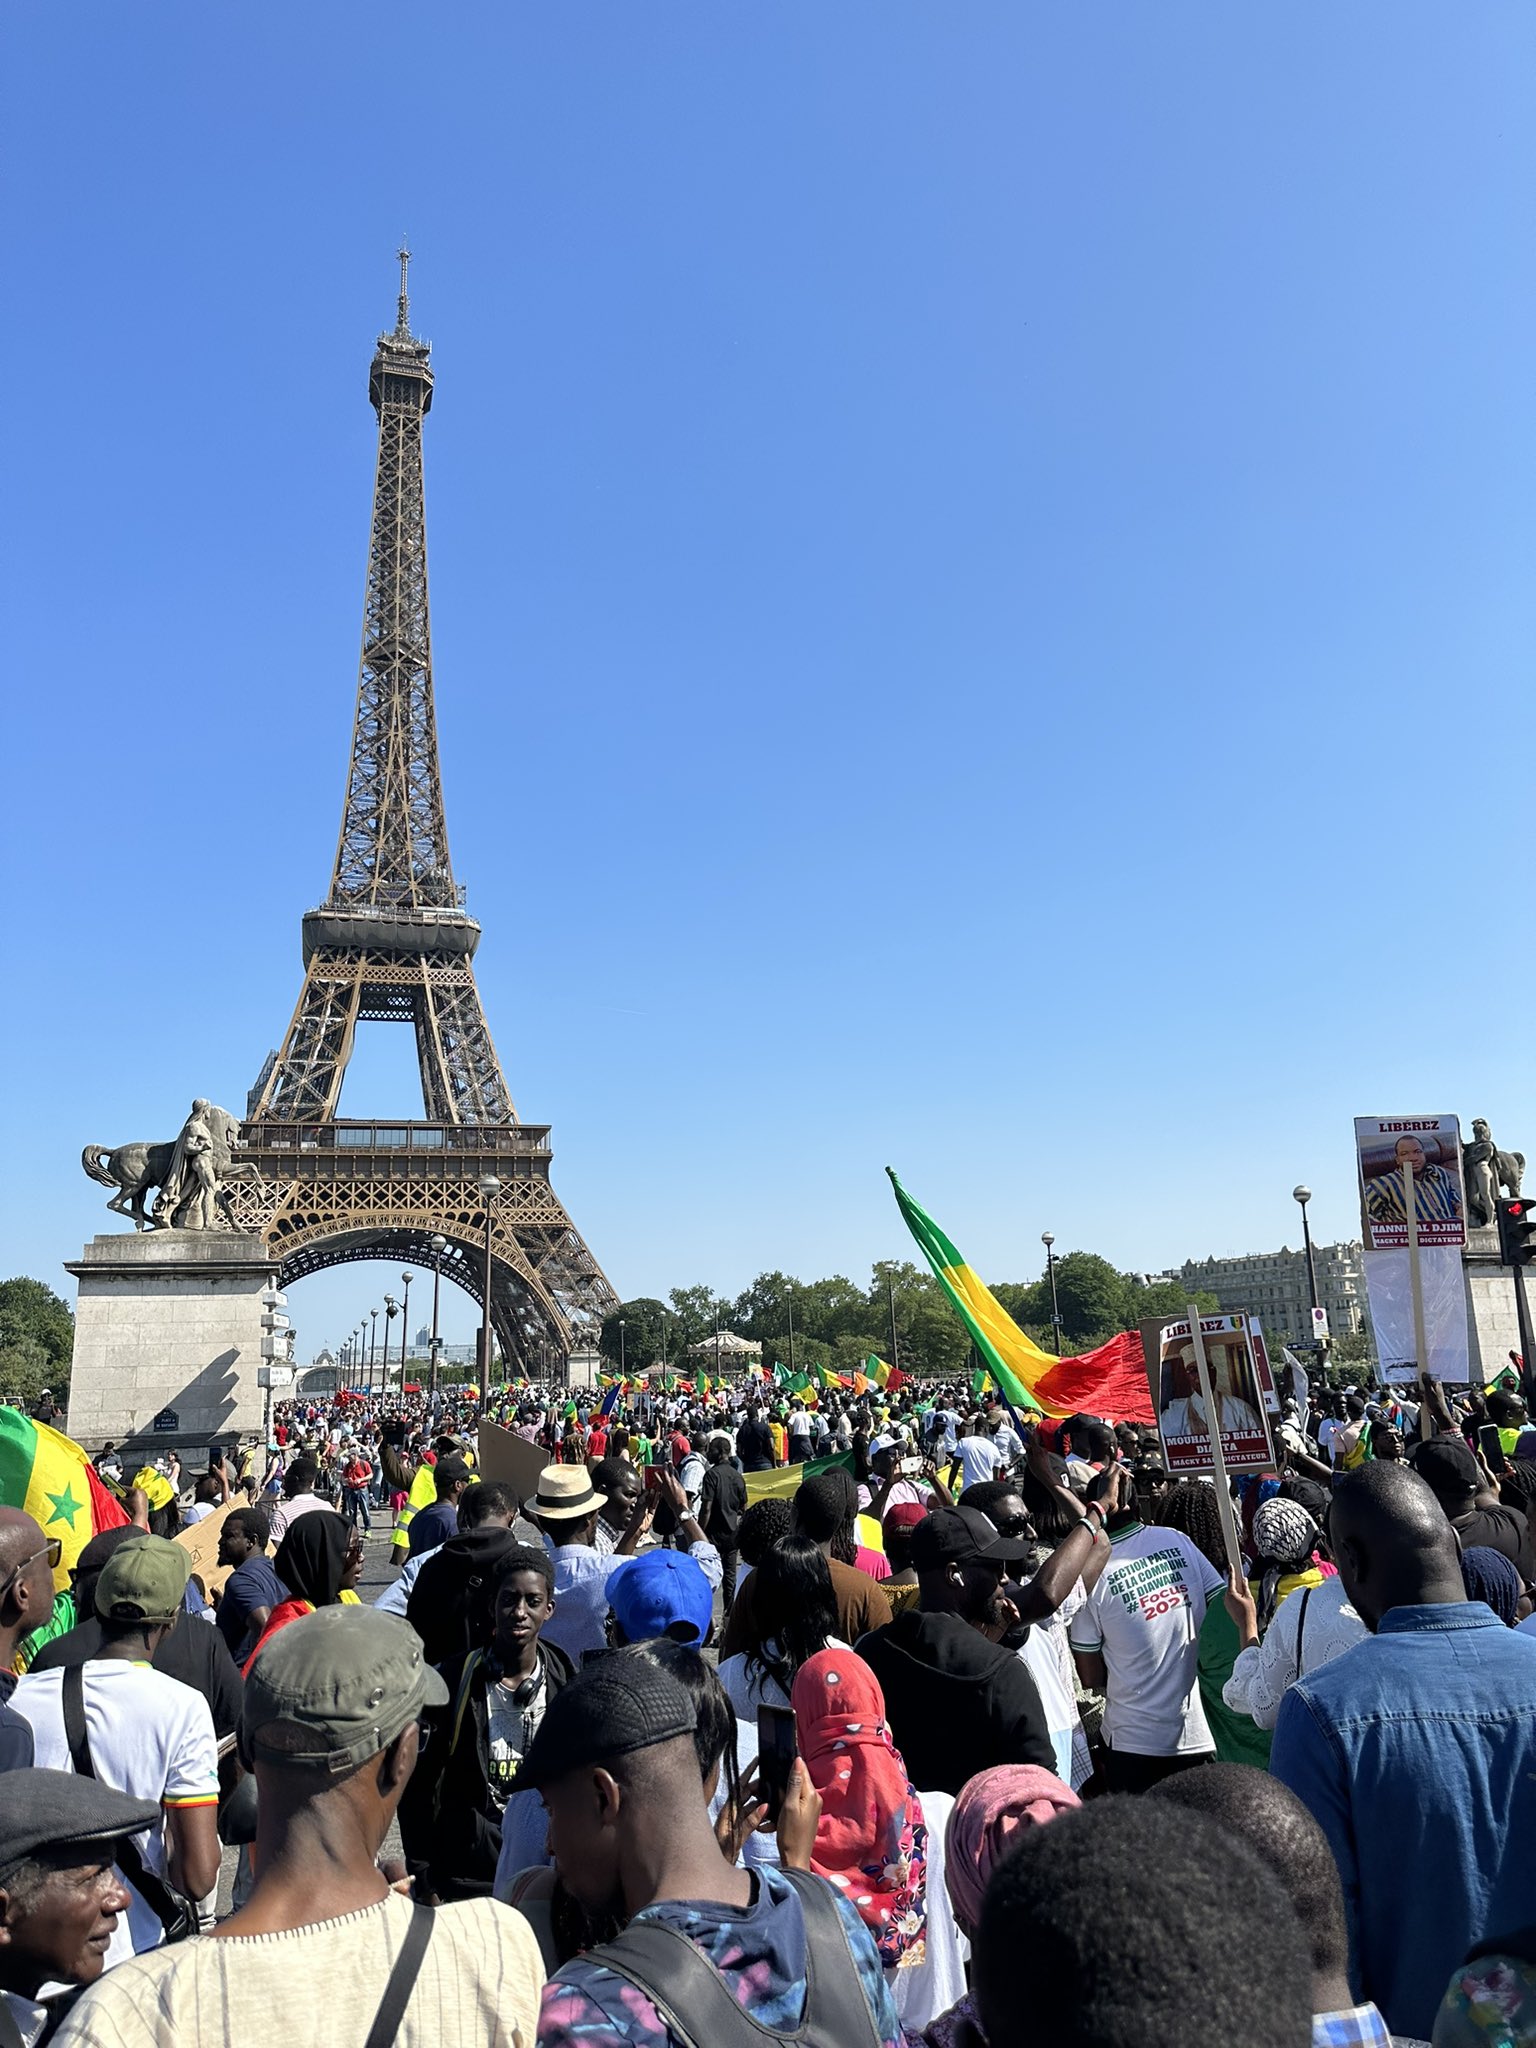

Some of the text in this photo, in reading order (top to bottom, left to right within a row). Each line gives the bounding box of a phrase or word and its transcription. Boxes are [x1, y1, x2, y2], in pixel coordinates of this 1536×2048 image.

[1379, 1120, 1439, 1132] LIBÉREZ
[1371, 1223, 1462, 1233] HANNIAL DJIM
[1232, 1429, 1265, 1441] BILAL
[1196, 1442, 1238, 1454] DIATA
[1173, 1458, 1200, 1466] MACKY
[1107, 1547, 1182, 1585] SECTION PASTEF
[1110, 1557, 1188, 1596] DE LA COMMUNE
[1122, 1571, 1184, 1604] DE DIAWARA
